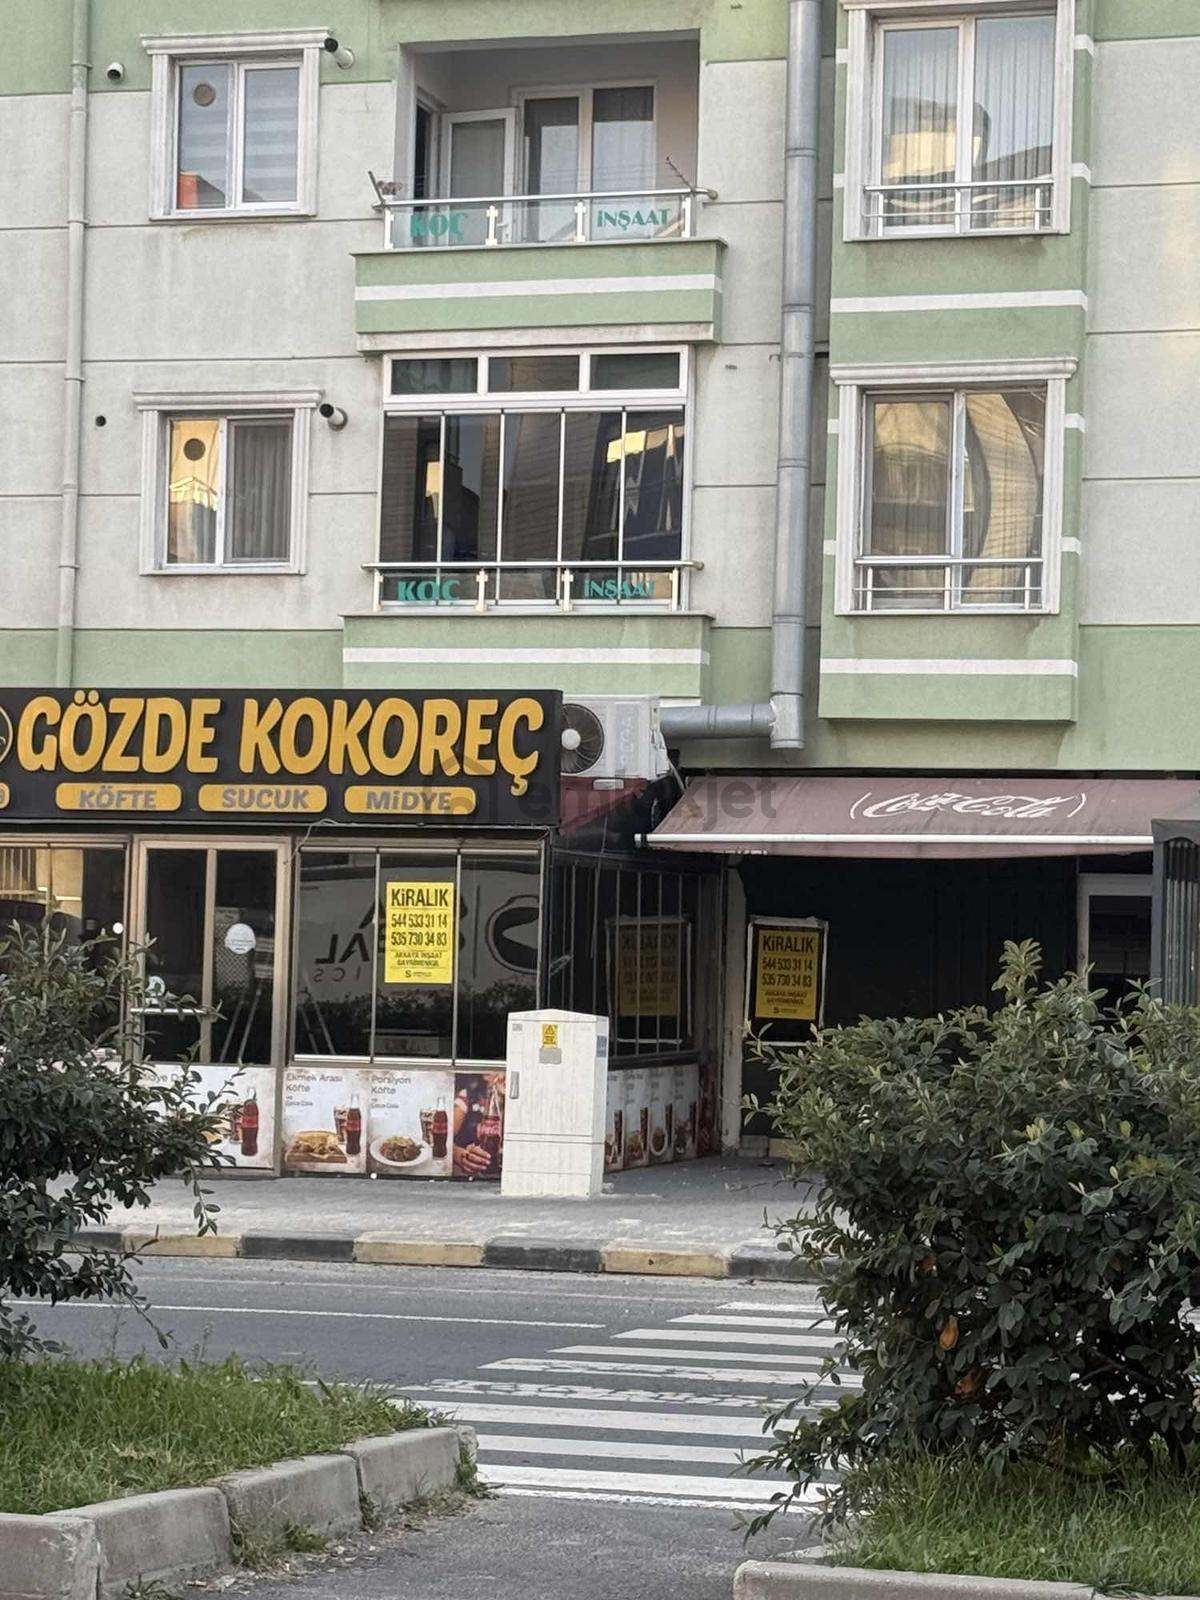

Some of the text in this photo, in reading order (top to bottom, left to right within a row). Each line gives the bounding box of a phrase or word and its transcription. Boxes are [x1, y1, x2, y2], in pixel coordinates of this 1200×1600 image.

[17, 690, 221, 773] GÖZDE
[239, 697, 545, 796] KOKOREÇ
[79, 784, 157, 810] KÖFTE
[222, 788, 310, 810] SUCUK
[391, 913, 448, 928] 544 533 31 14
[390, 931, 447, 946] 535 730 34 83
